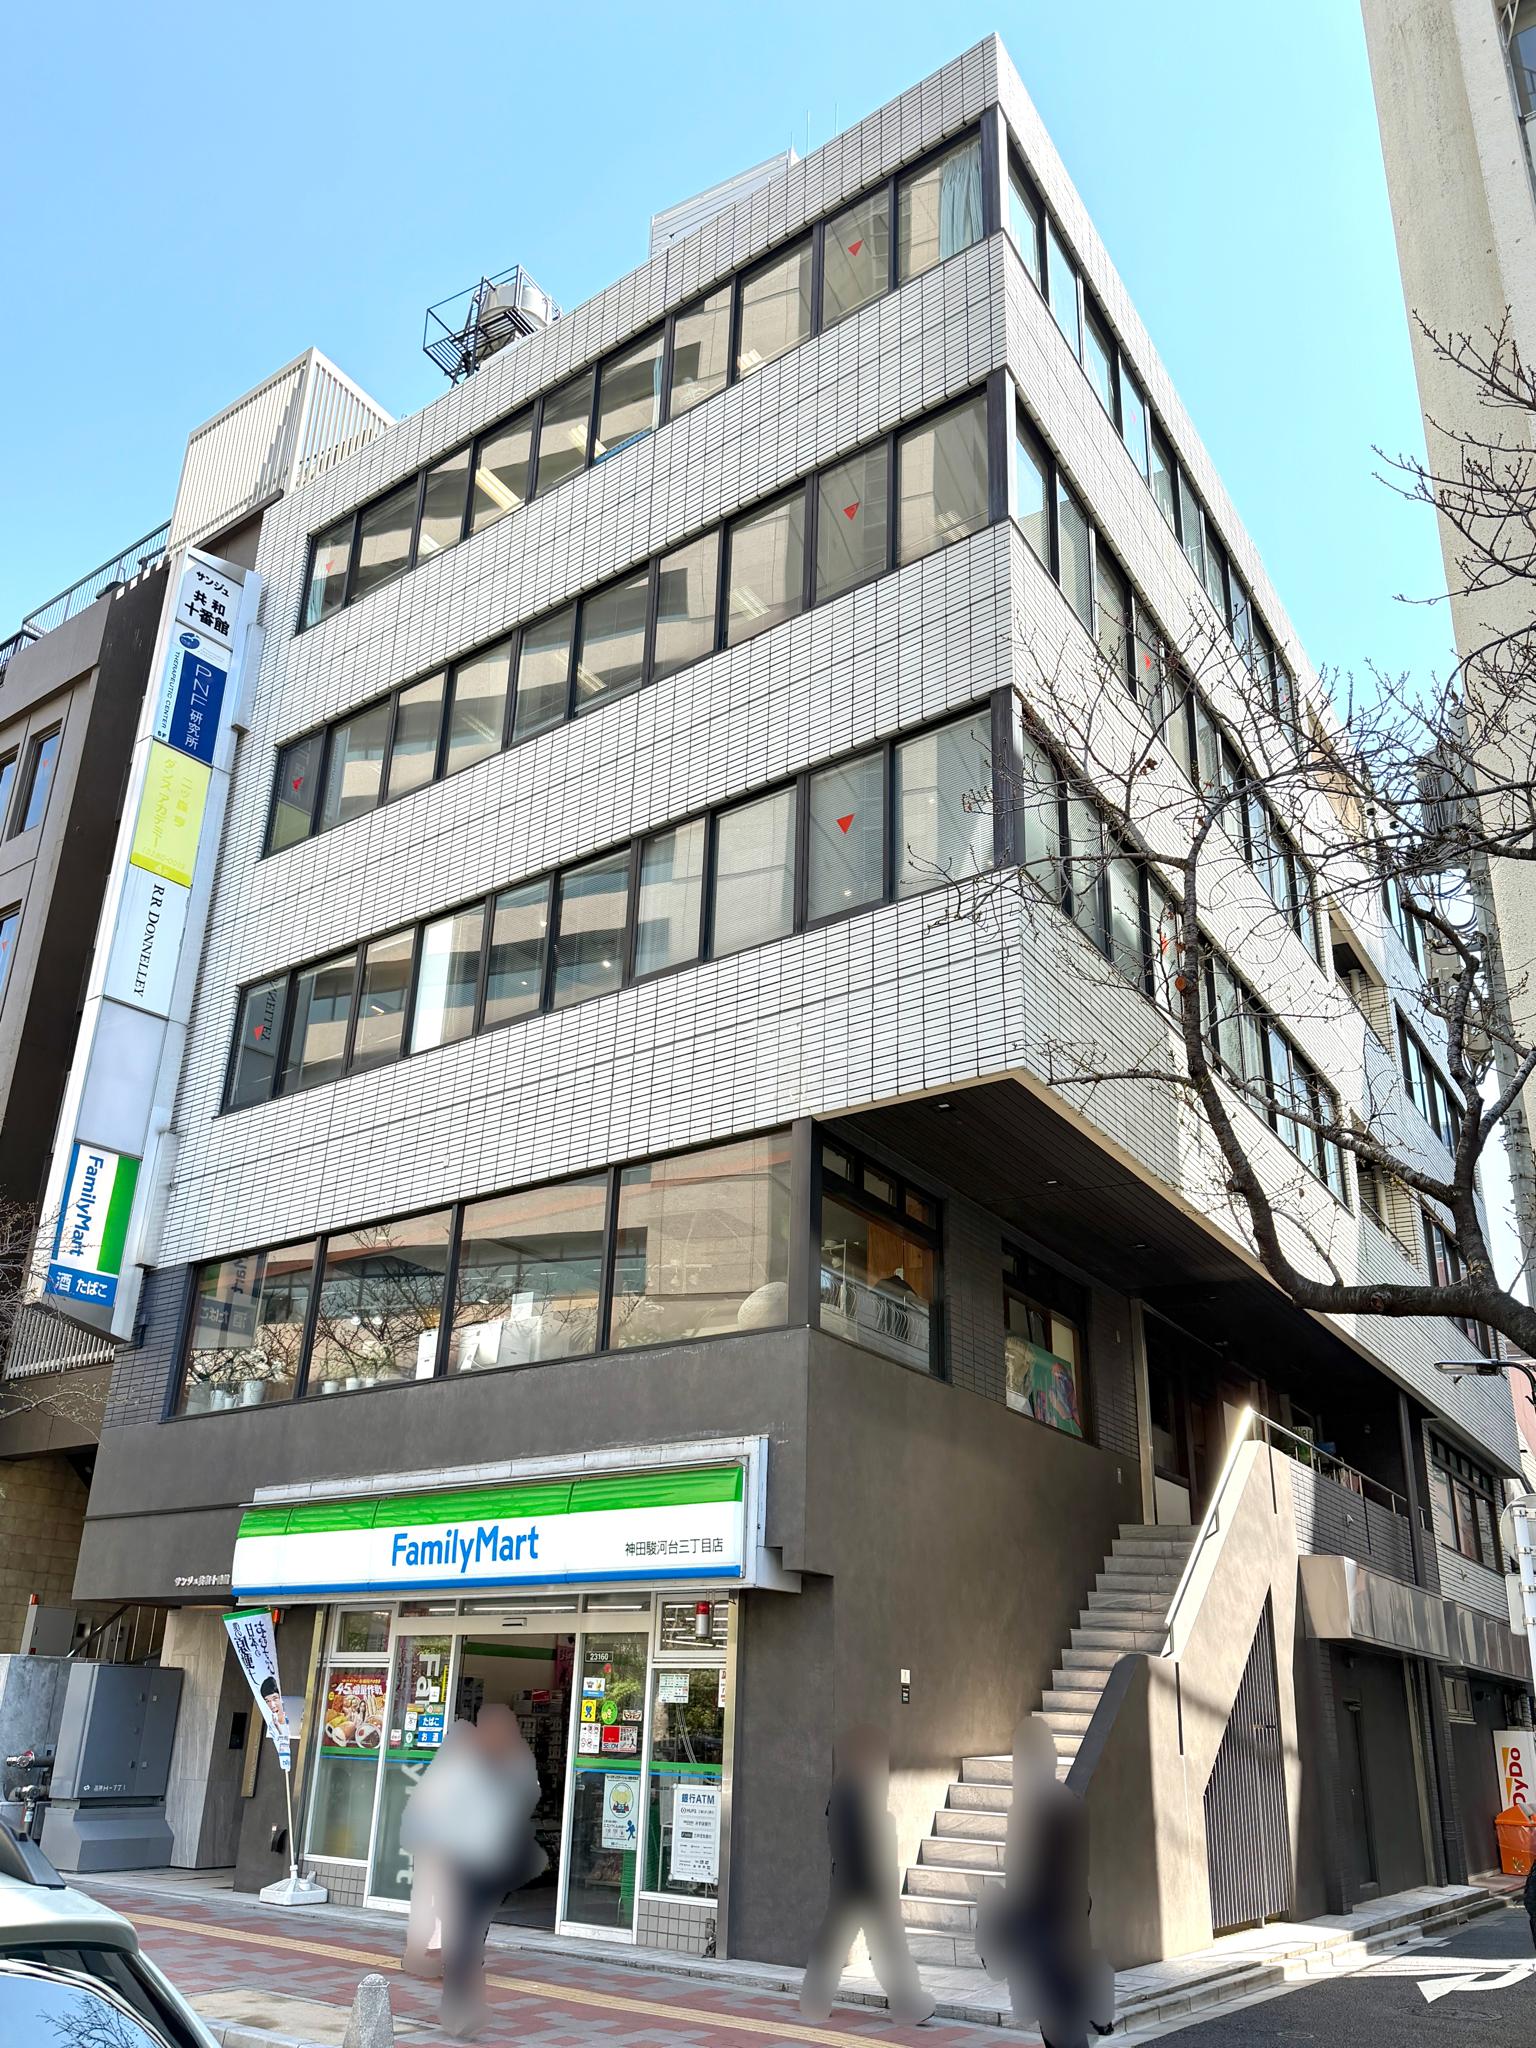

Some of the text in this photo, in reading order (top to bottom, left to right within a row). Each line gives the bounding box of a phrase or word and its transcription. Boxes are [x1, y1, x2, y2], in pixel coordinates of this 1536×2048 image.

[196, 571, 230, 598] サンジュ
[193, 590, 226, 617] 共和
[184, 602, 230, 637] 十番館
[161, 651, 180, 729] THERAPEUTIC CENTER
[191, 664, 212, 706] PNF
[184, 708, 204, 751] 研究所
[134, 911, 160, 998] DONNELLEY
[69, 1155, 104, 1257] FamilyMart
[55, 1271, 108, 1298] 酒 たばこ
[391, 1525, 539, 1573] FamilyMart
[625, 1537, 723, 1556] 神田駿河台三丁目店
[590, 1652, 609, 1660] 23160
[423, 1717, 439, 1726] たばこ
[681, 1793, 715, 1805] 銀行ATM
